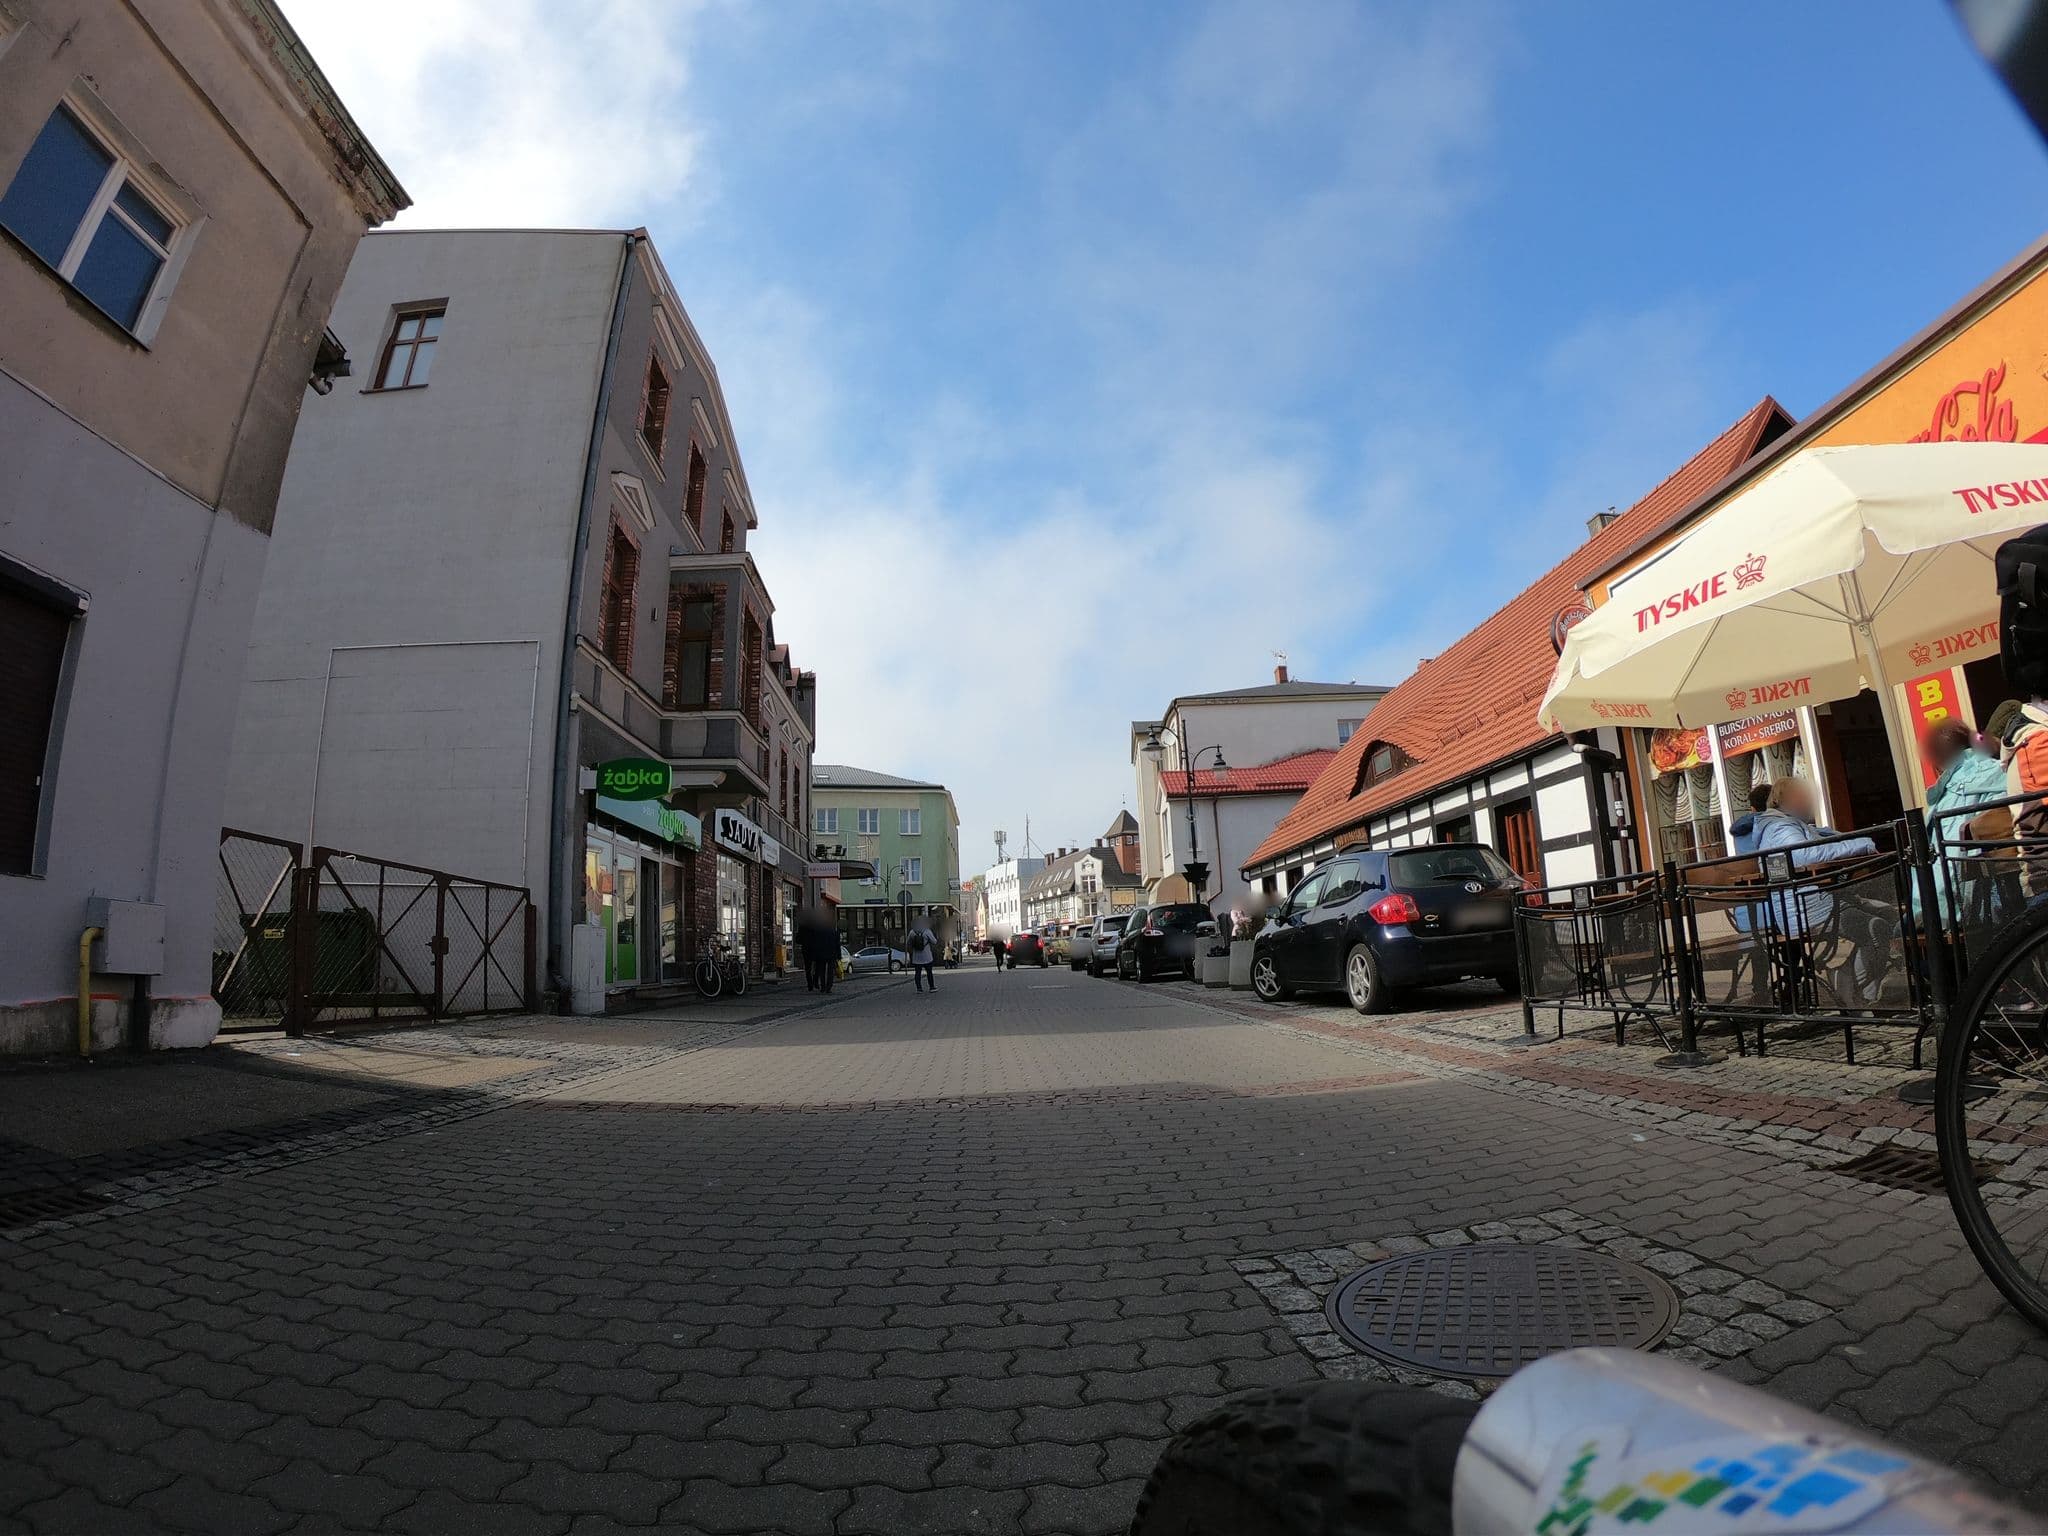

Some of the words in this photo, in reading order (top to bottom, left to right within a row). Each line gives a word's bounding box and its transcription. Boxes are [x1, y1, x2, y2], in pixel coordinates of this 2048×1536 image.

[1633, 571, 1727, 633] TYSKIE
[1718, 714, 1764, 737] BURSZTYN
[1724, 732, 1755, 750] KORAL
[603, 769, 663, 786] żabka
